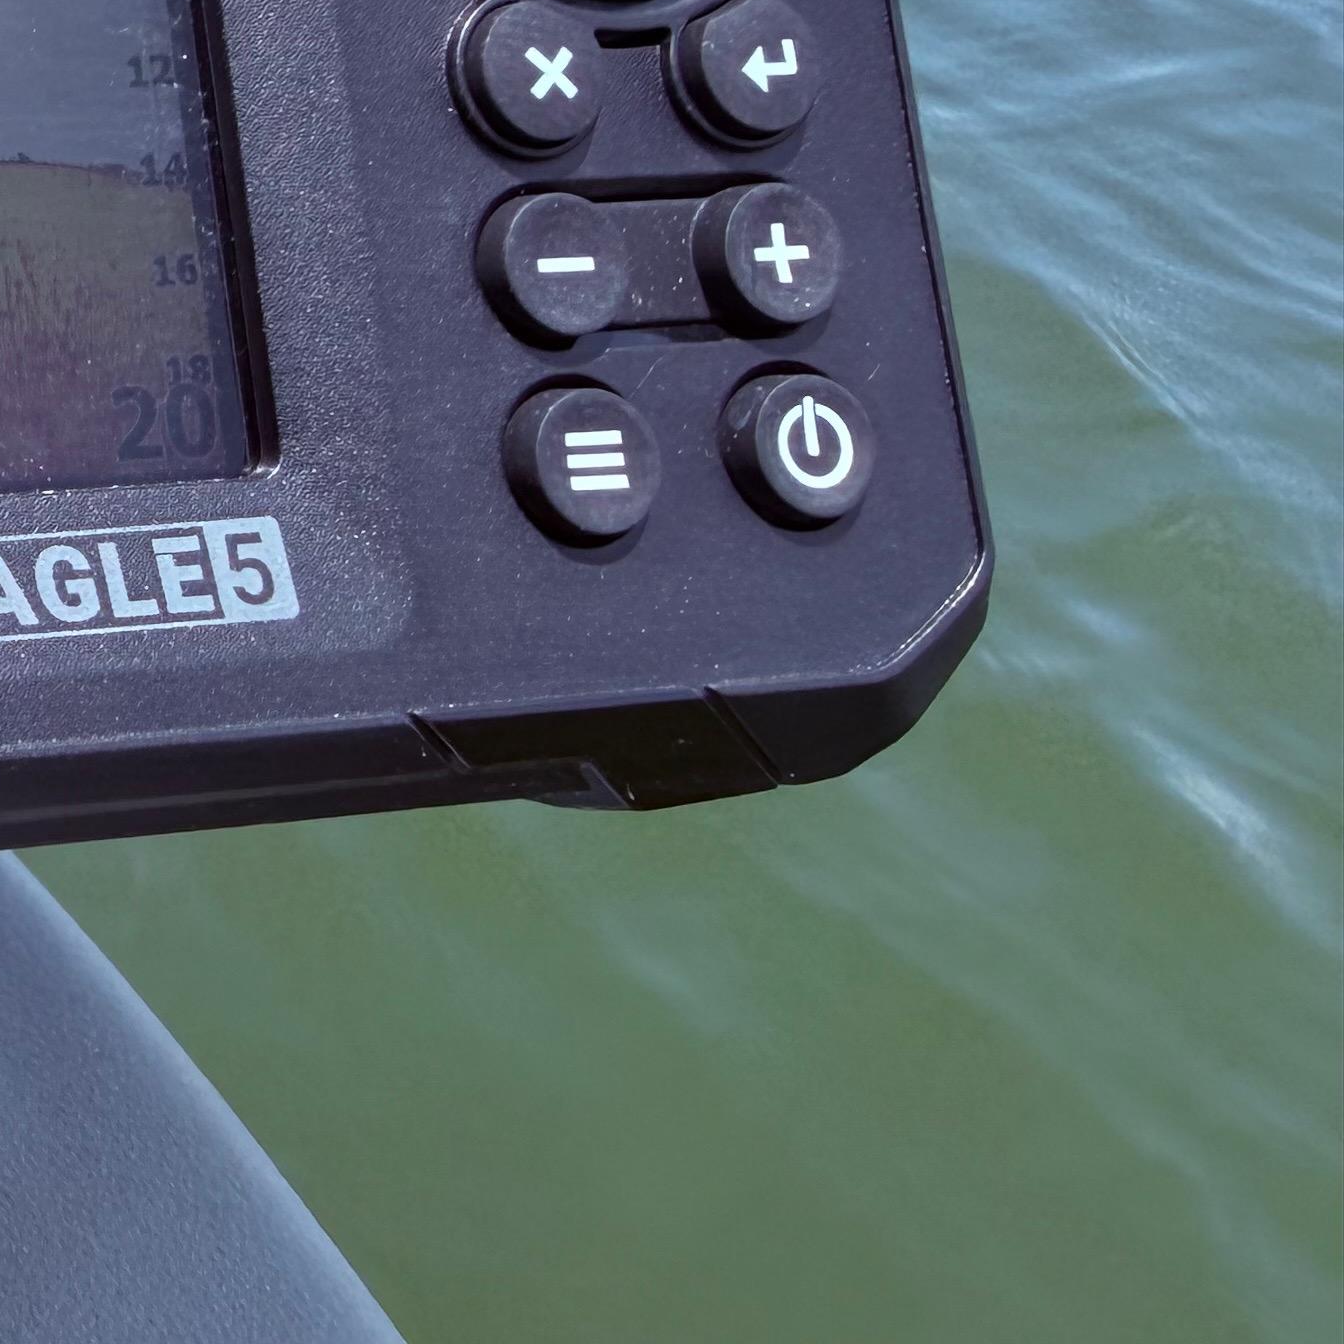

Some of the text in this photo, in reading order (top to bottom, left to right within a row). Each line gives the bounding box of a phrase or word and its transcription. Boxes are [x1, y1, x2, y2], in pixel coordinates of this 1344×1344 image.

[126, 53, 177, 89] 12
[152, 253, 199, 288] 16
[111, 385, 217, 462] 20
